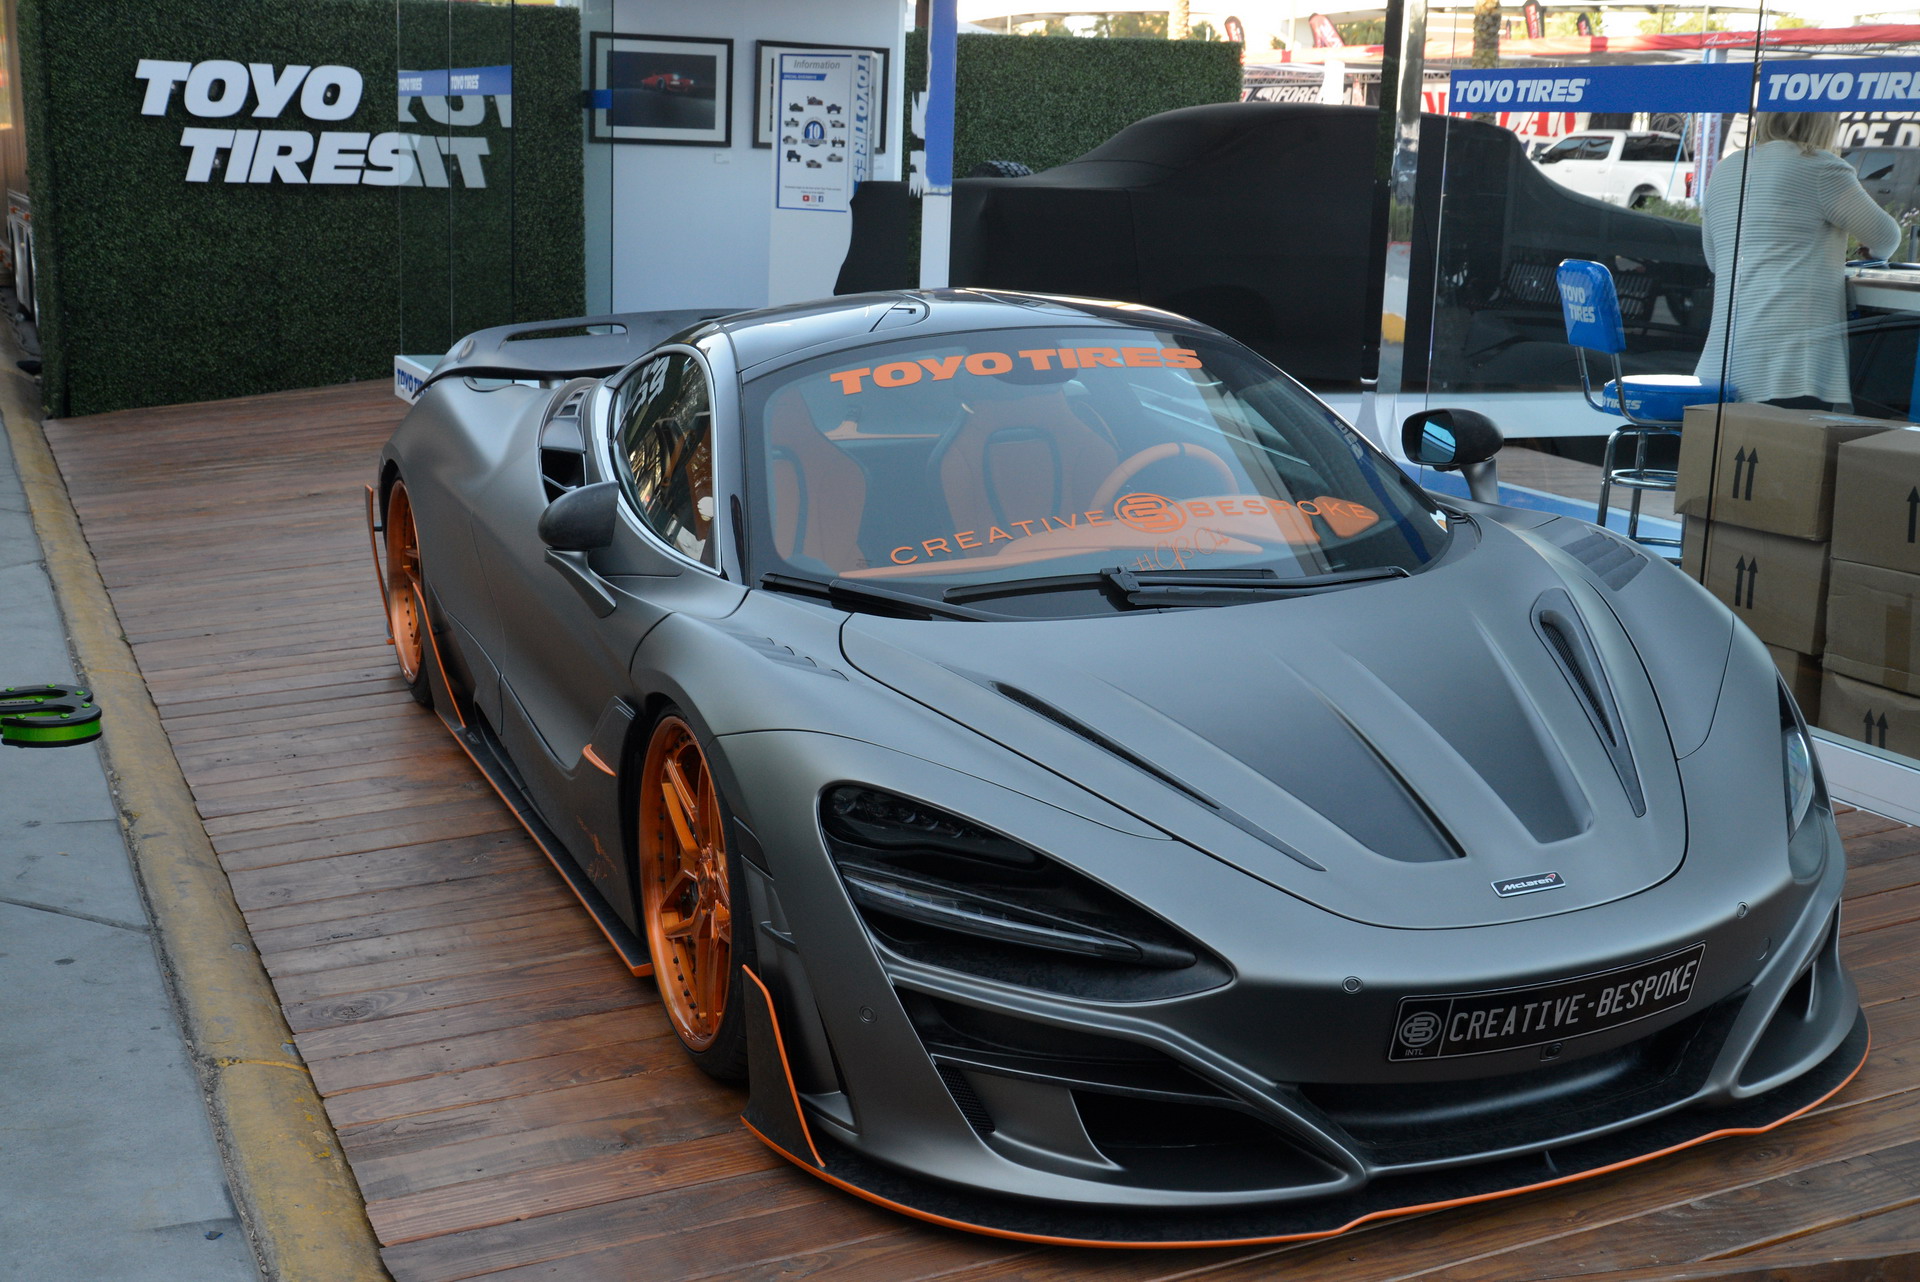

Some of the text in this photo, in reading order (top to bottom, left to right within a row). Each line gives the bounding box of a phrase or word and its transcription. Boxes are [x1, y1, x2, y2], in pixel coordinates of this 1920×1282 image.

[793, 59, 841, 70] Information
[135, 59, 363, 121] TOYO
[1455, 79, 1514, 103] TOYO
[1768, 71, 1920, 101] TOYO TIRE
[808, 124, 821, 140] 10
[180, 127, 414, 187] TIRES
[1561, 283, 1586, 304] TOYO
[1568, 304, 1596, 324] TIRES
[830, 346, 1204, 396] TOYO TIRES
[890, 508, 1114, 566] CREATIVE
[1185, 499, 1374, 519] BESPOKE
[1502, 877, 1554, 892] McLaren
